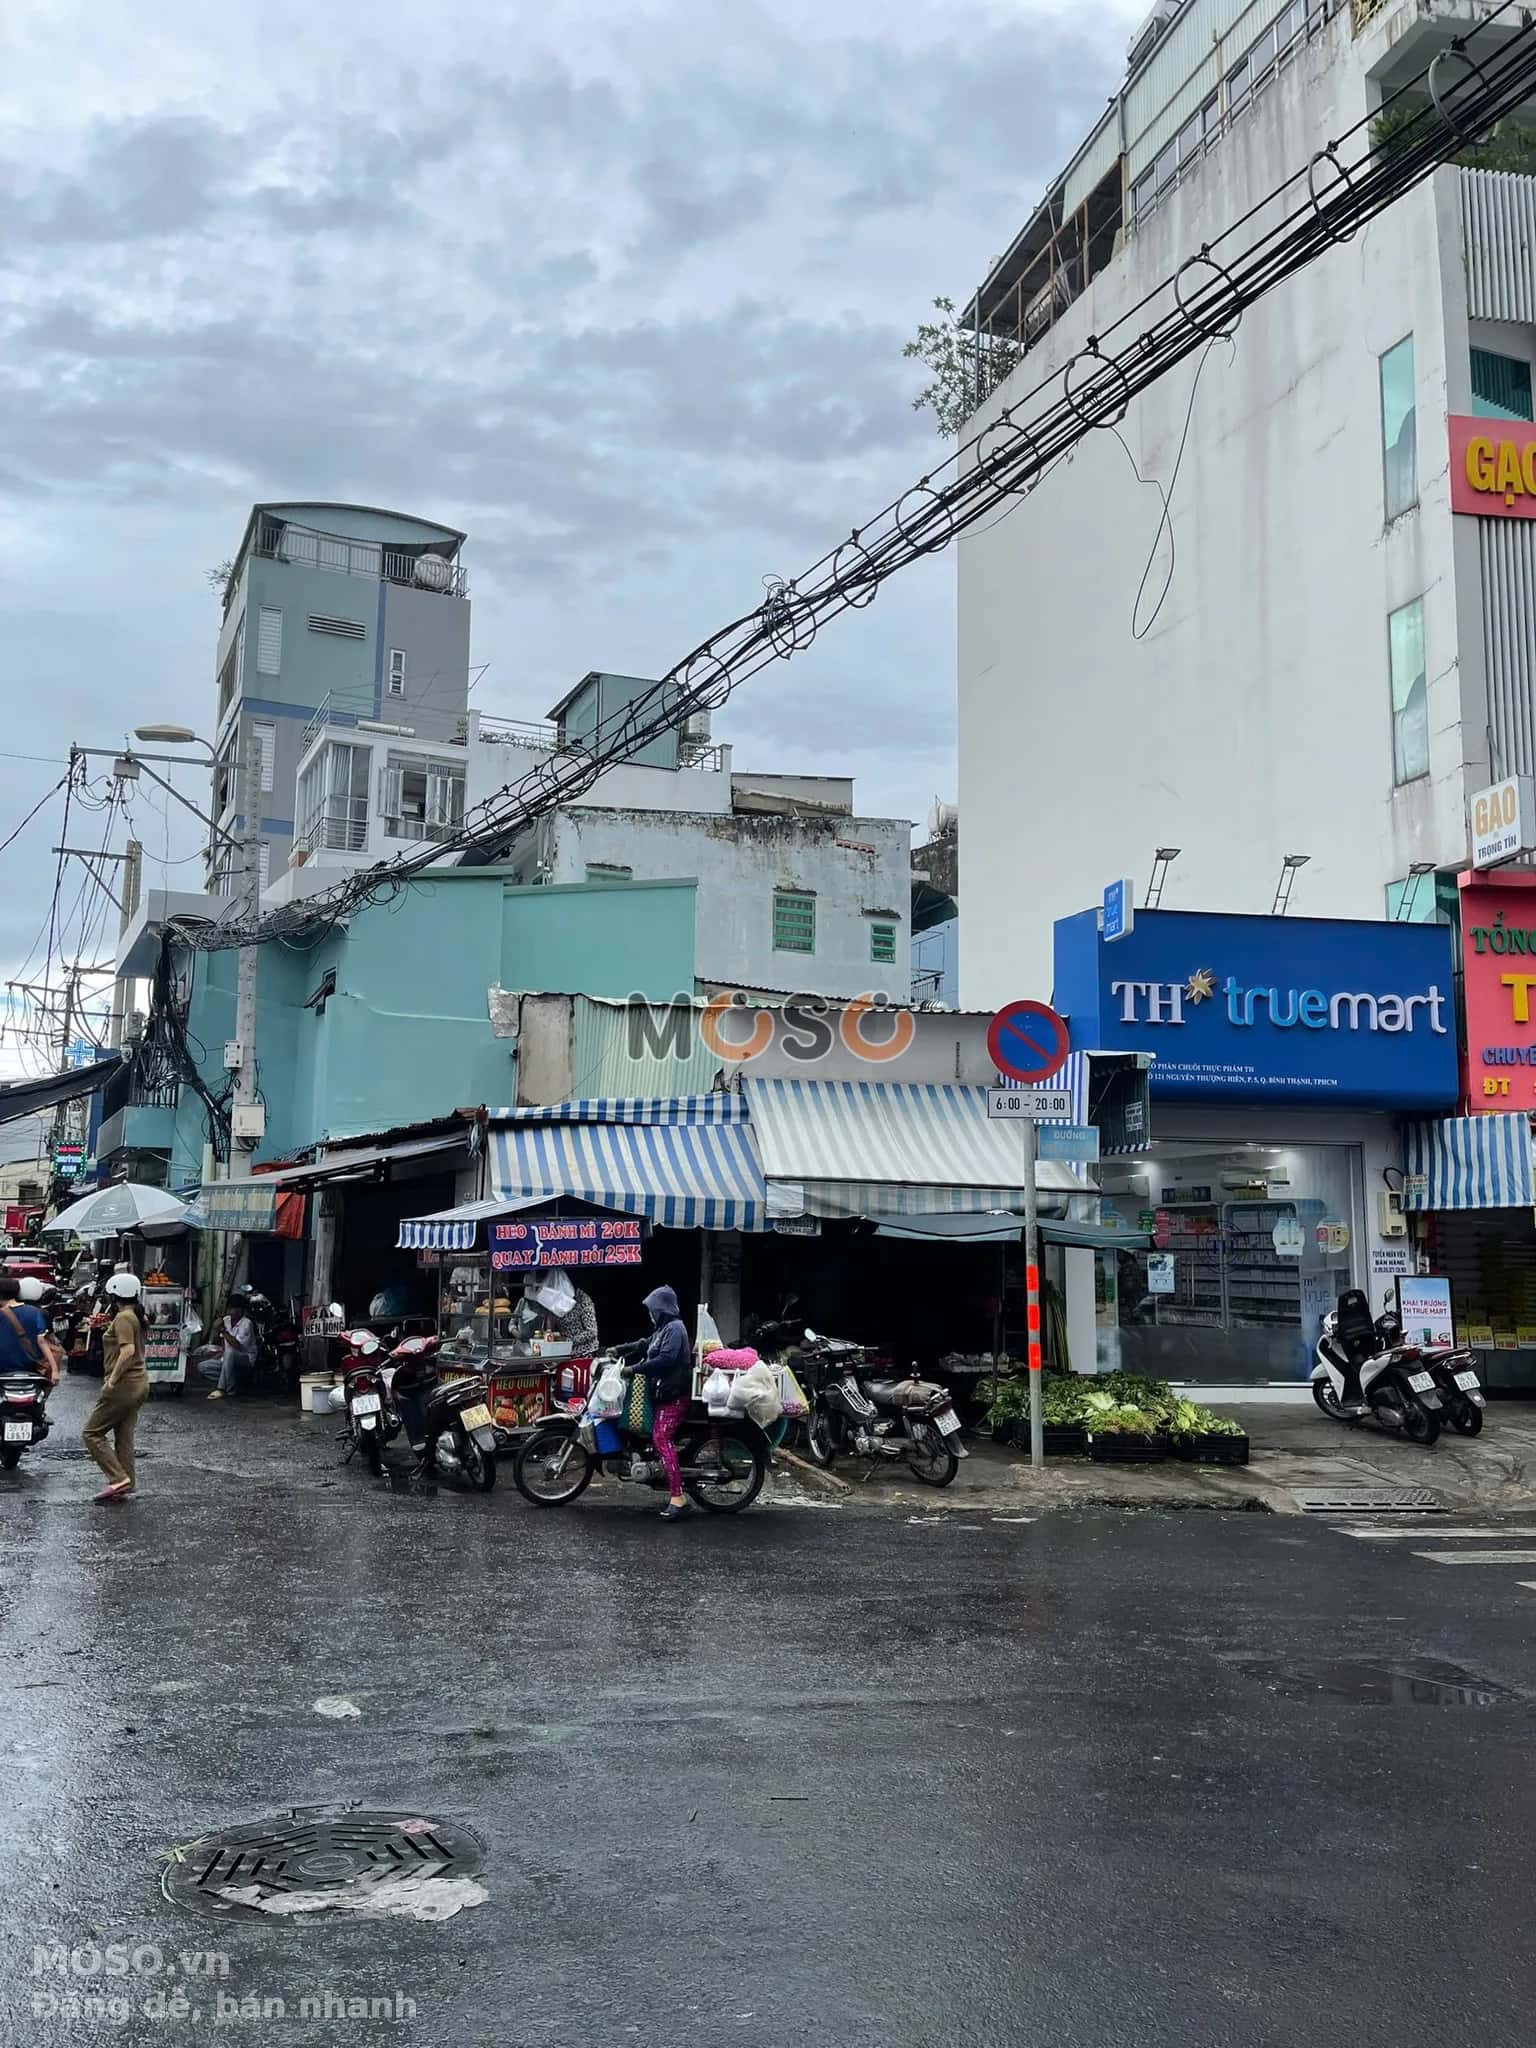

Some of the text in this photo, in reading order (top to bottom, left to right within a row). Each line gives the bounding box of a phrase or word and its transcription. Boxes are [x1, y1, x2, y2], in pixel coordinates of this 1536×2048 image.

[1478, 833, 1517, 860] TRỌNG TÍN
[1112, 981, 1186, 1024] TH
[1313, 1078, 1337, 1086] TPHCM
[1483, 1077, 1510, 1095] ĐT
[996, 1097, 1020, 1110] 6:00
[1035, 1097, 1065, 1110] 20:00
[496, 1221, 640, 1241] HEO BÁNH MÌ 20K
[492, 1250, 534, 1269] QUAY
[540, 1248, 579, 1265] BÁNH
[604, 1244, 642, 1263] 25K
[1413, 1307, 1429, 1315] TRUE
[1429, 1307, 1447, 1315] MART
[496, 1379, 515, 1391] HEO
